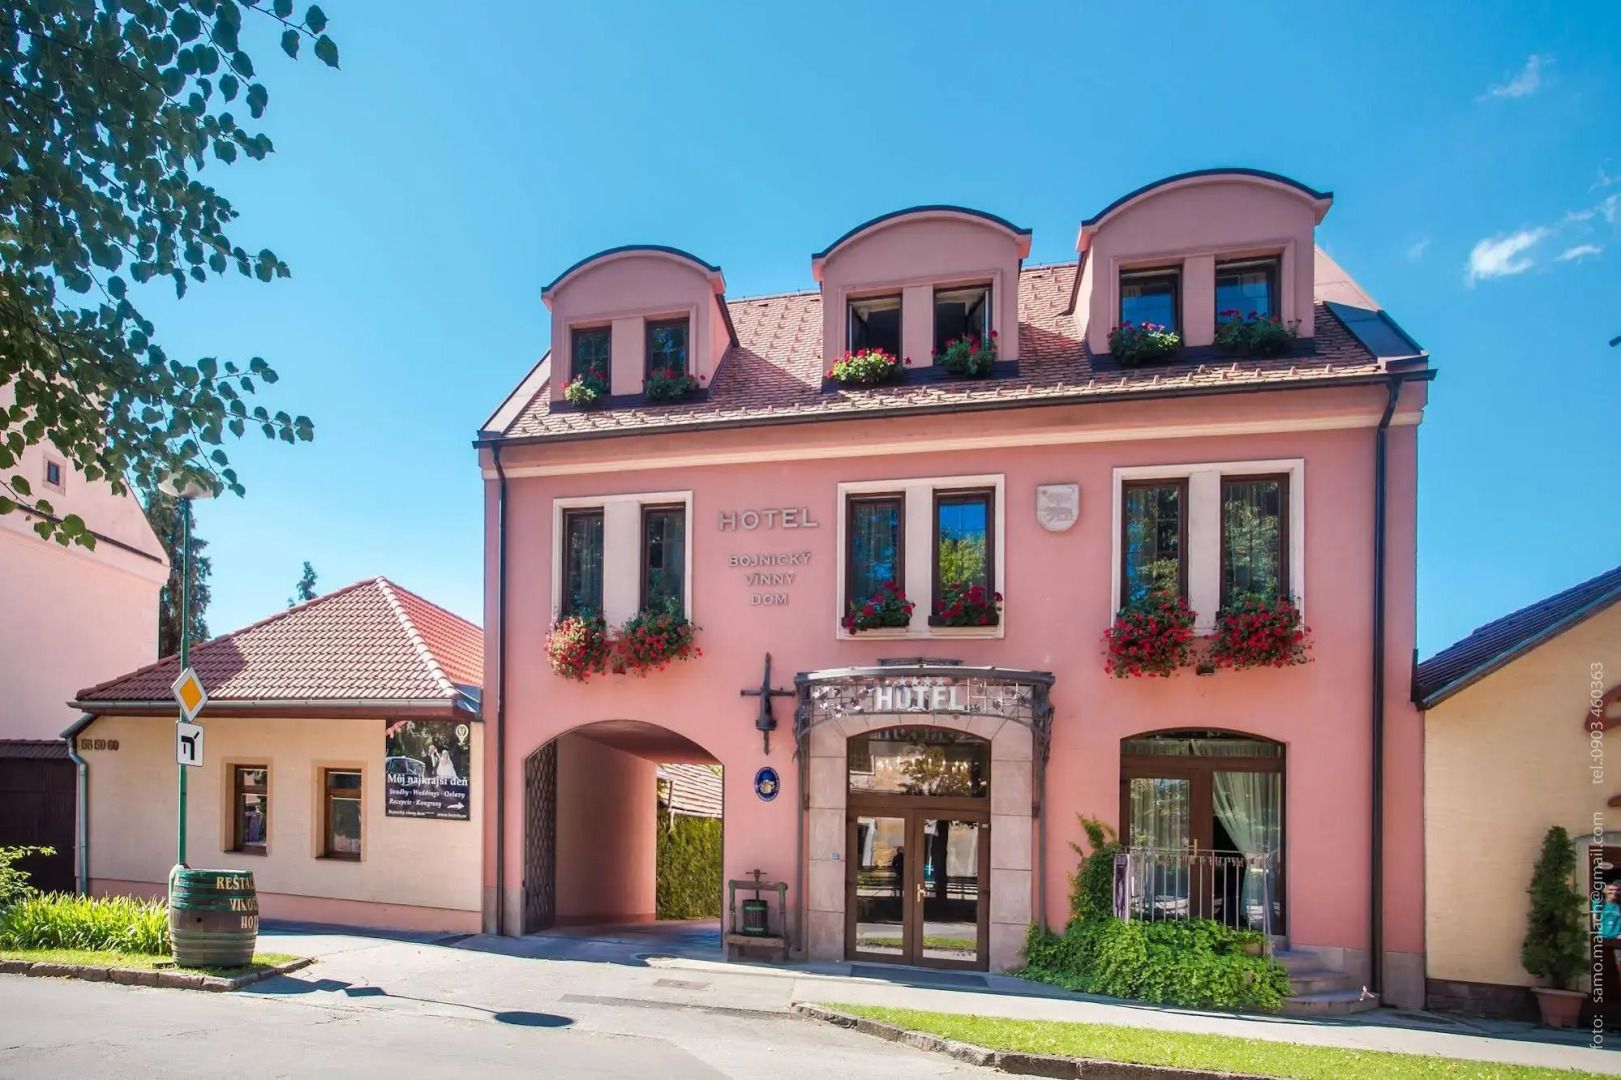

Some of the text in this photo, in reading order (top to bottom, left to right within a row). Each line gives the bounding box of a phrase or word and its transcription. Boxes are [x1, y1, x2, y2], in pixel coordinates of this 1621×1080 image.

[718, 507, 819, 531] HOTEL
[751, 594, 788, 605] DOM
[874, 684, 965, 711] HOTEL
[387, 773, 405, 786] Môj
[450, 776, 468, 786] deň
[413, 789, 440, 798] Weddings
[444, 790, 466, 800] Oslavy
[416, 799, 442, 808] Kongresy
